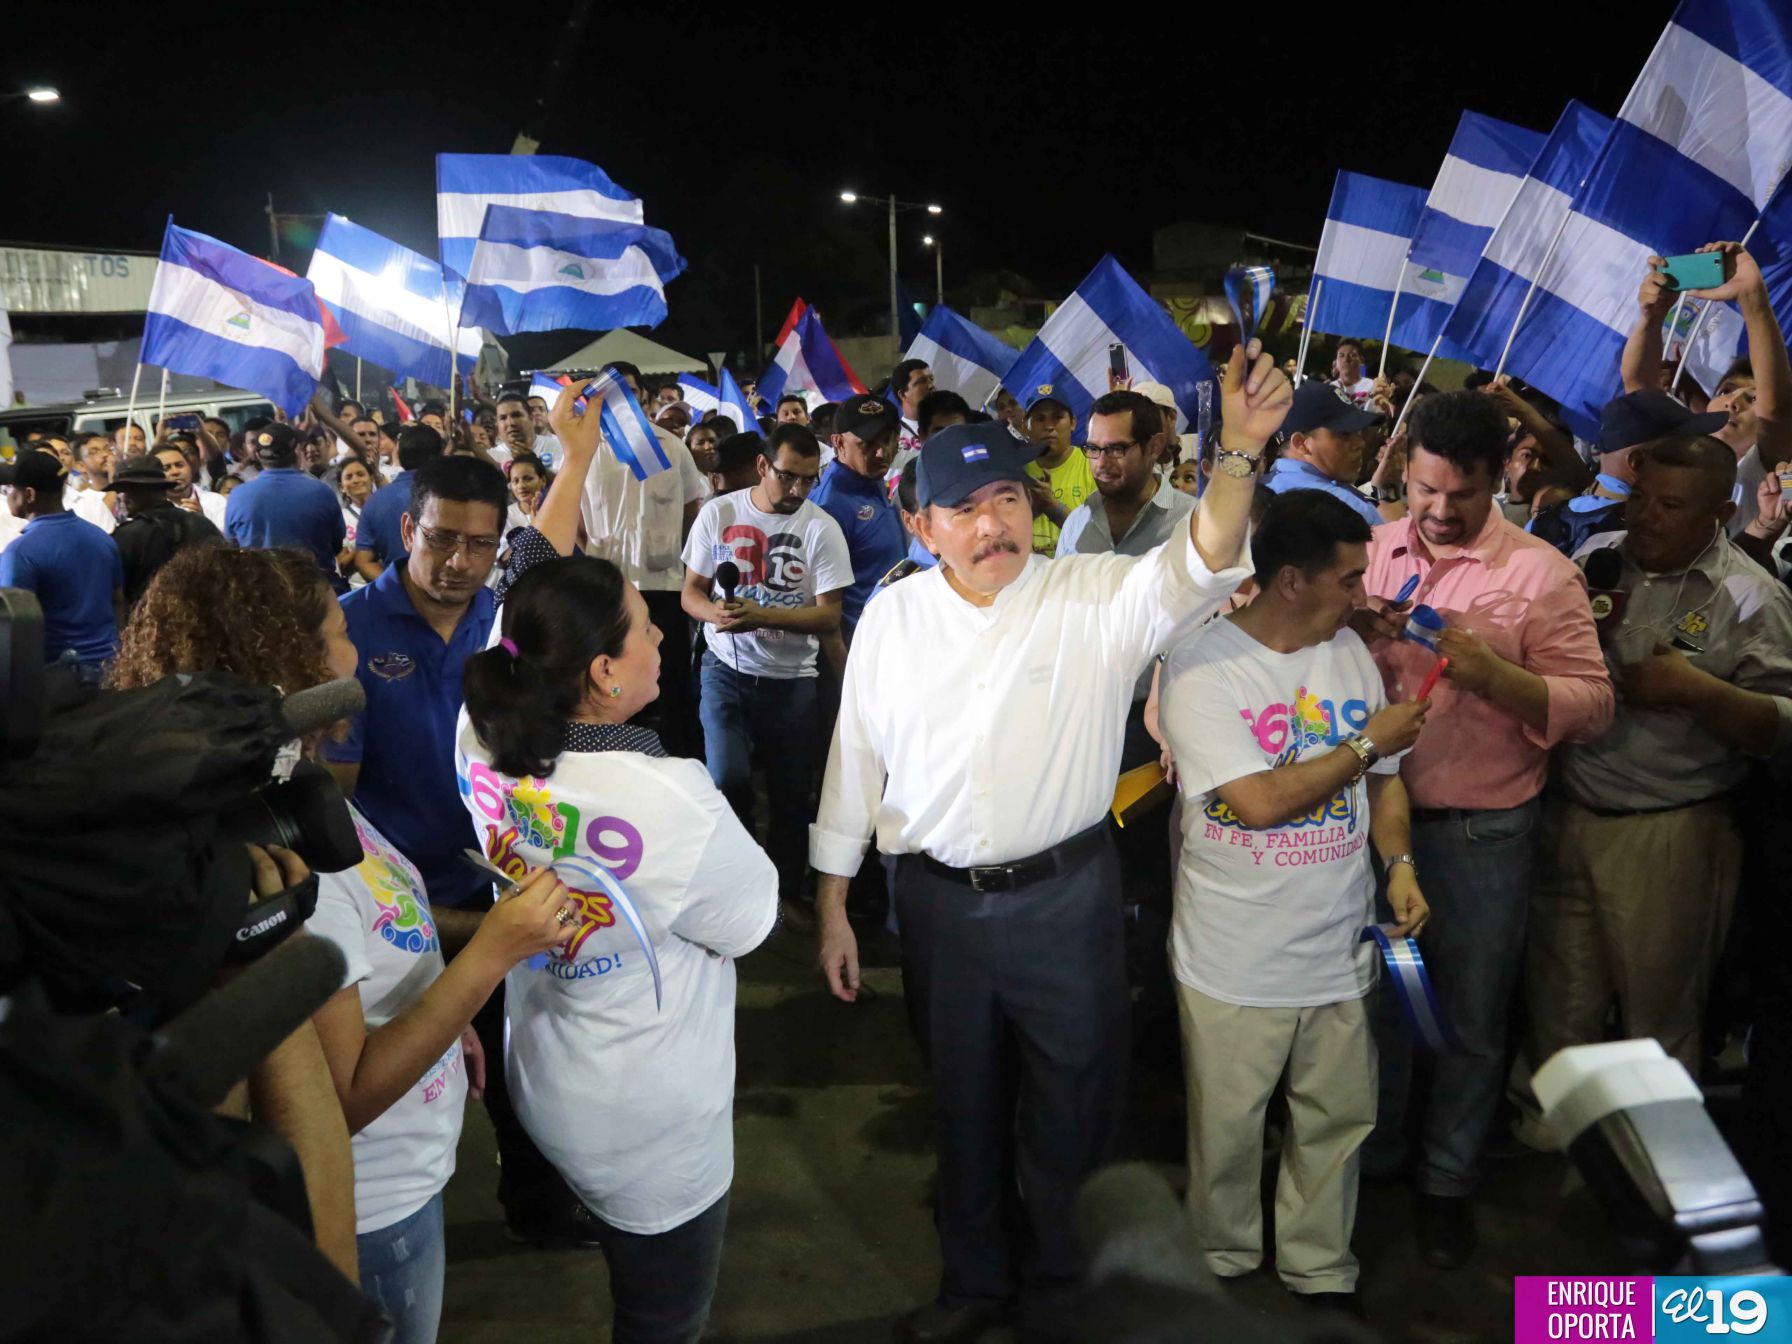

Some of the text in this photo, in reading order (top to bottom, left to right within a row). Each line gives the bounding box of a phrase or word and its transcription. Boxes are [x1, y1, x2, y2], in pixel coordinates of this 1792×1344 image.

[552, 801, 644, 881] 19
[1204, 823, 1224, 841] EN
[1265, 826, 1346, 849] FAMILIA
[1252, 851, 1264, 865] Y
[236, 909, 287, 941] Canon
